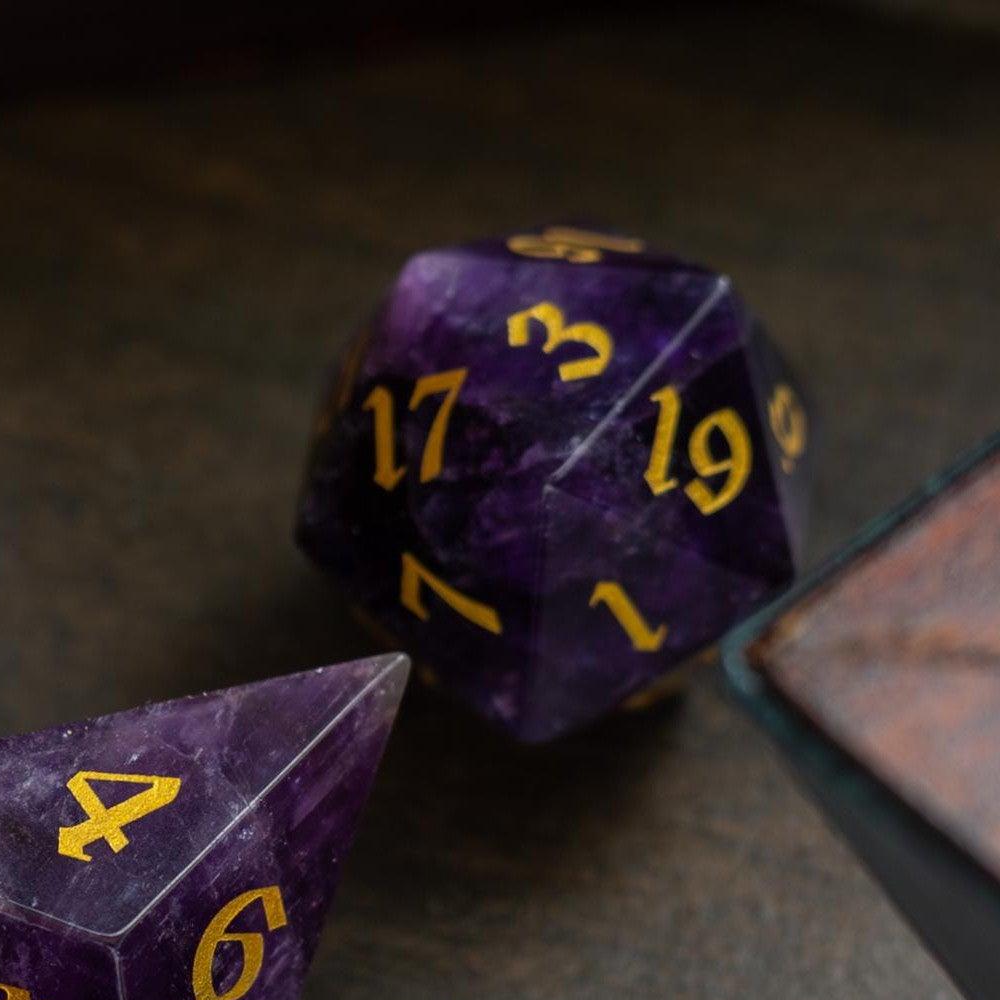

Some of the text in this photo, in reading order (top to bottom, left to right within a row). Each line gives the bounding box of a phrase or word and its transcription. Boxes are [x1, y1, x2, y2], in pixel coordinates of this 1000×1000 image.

[508, 303, 613, 381] 3
[364, 369, 468, 490] 17
[644, 386, 752, 515] 19
[402, 552, 500, 634] 7
[590, 581, 667, 652] 1
[58, 770, 181, 862] 4
